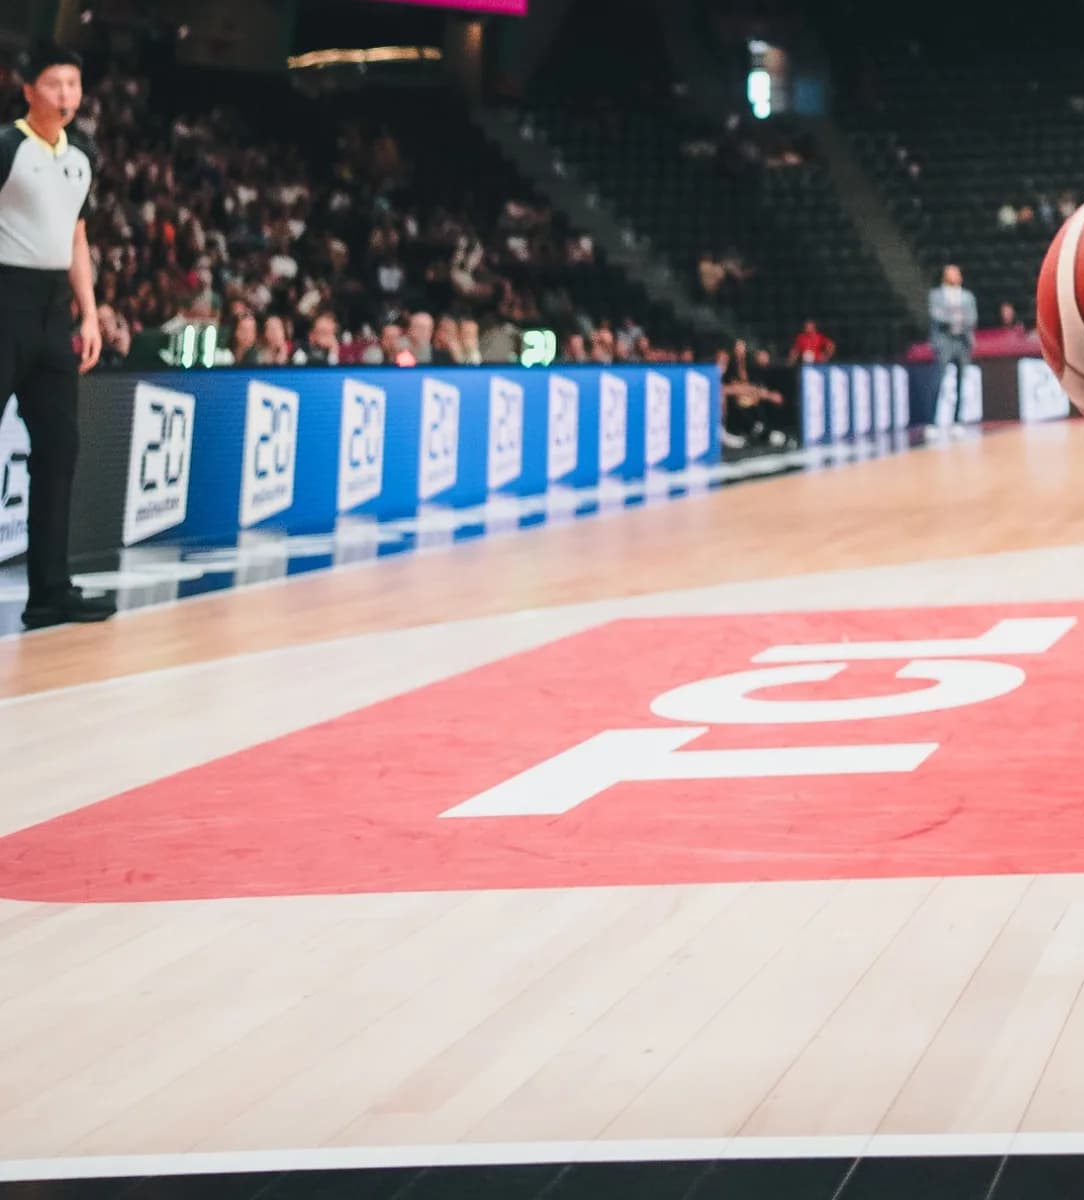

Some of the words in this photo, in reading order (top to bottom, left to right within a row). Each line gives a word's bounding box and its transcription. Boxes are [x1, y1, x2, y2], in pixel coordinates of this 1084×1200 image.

[141, 402, 186, 491] 20
[255, 398, 292, 479] 20
[350, 394, 381, 468] 20
[437, 616, 1078, 818] TCL
